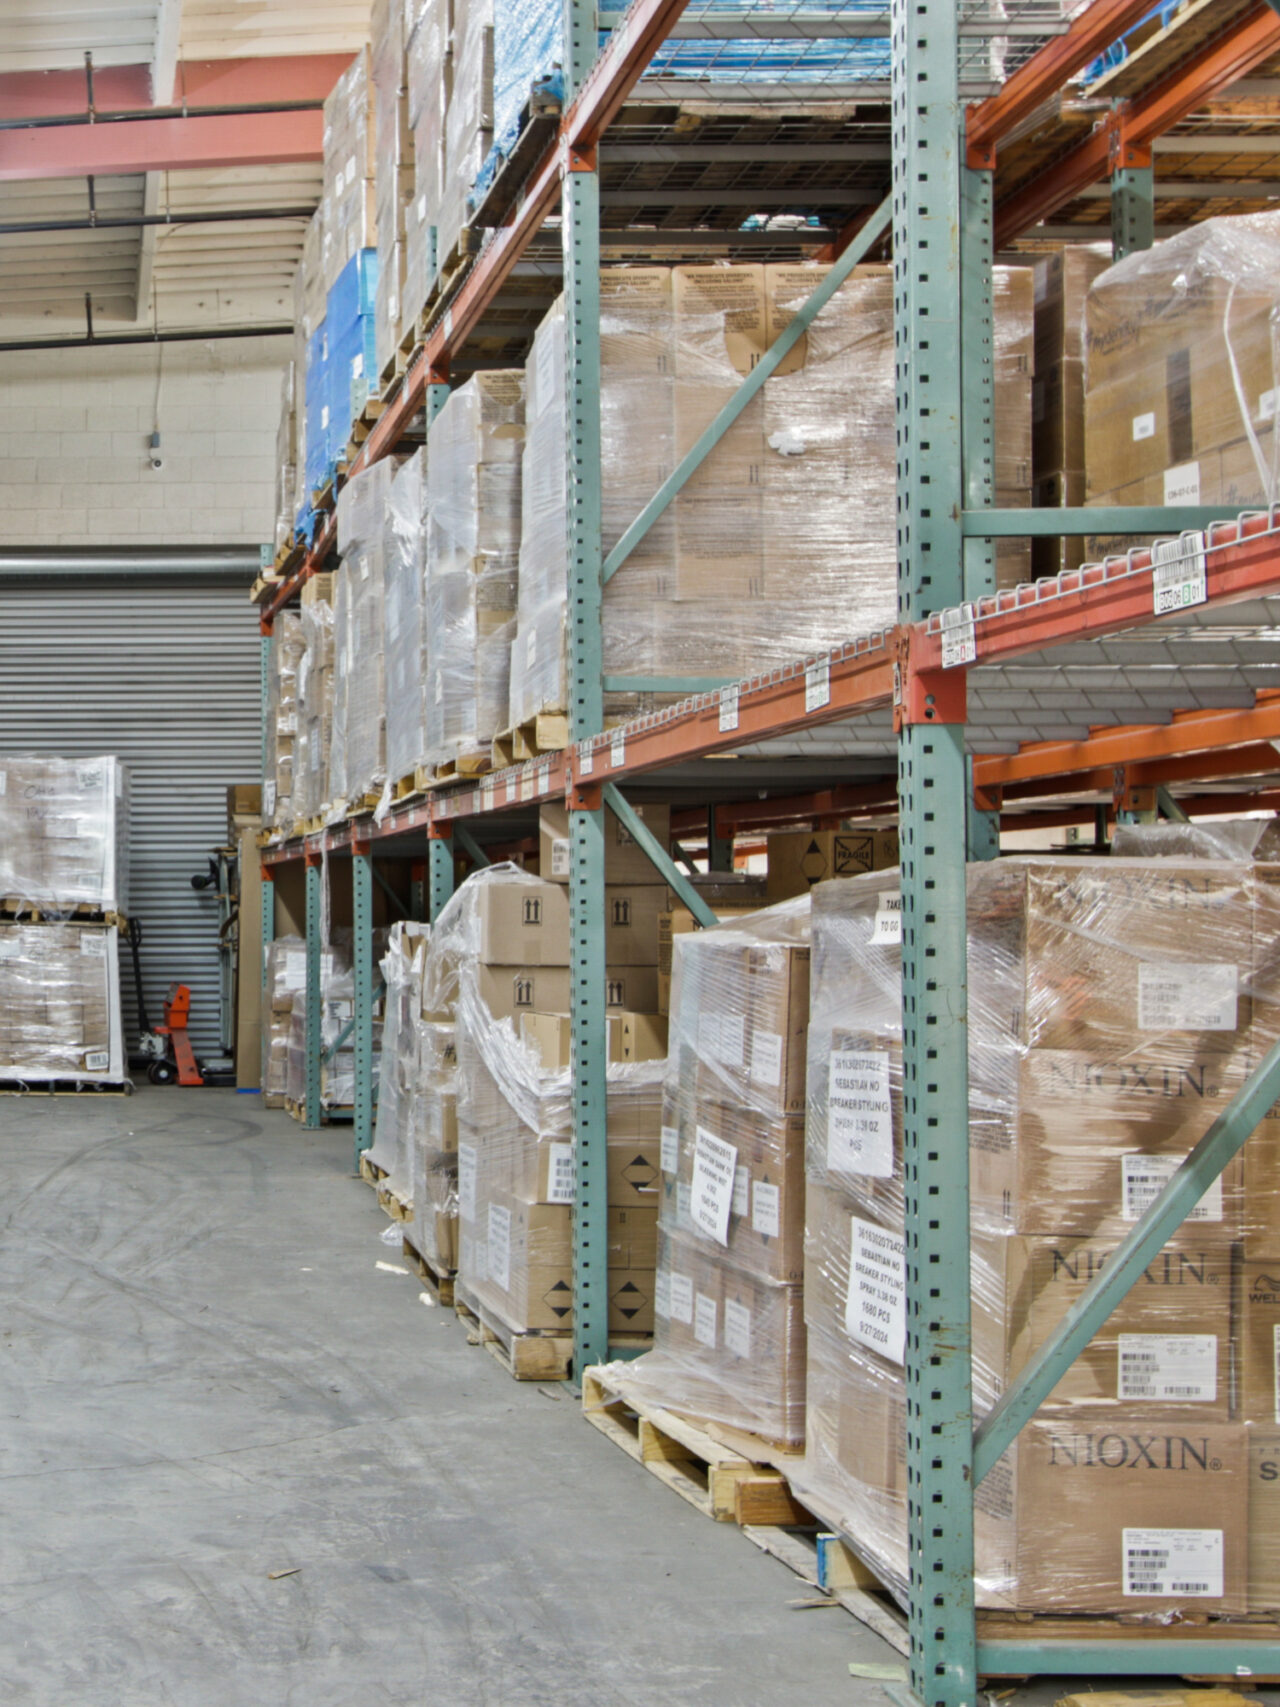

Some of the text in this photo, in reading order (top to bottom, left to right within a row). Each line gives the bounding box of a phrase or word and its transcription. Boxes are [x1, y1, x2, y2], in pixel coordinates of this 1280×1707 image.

[838, 851, 869, 859] FRAGILE
[861, 1247, 900, 1272] SEBASTIAN NO
[1051, 1250, 1207, 1285] NIIN
[855, 1261, 903, 1292] BREAKER STYLING
[860, 1281, 876, 1295] SPRAY
[878, 1308, 890, 1324] PCS
[1048, 1431, 1210, 1471] NIOXIN
